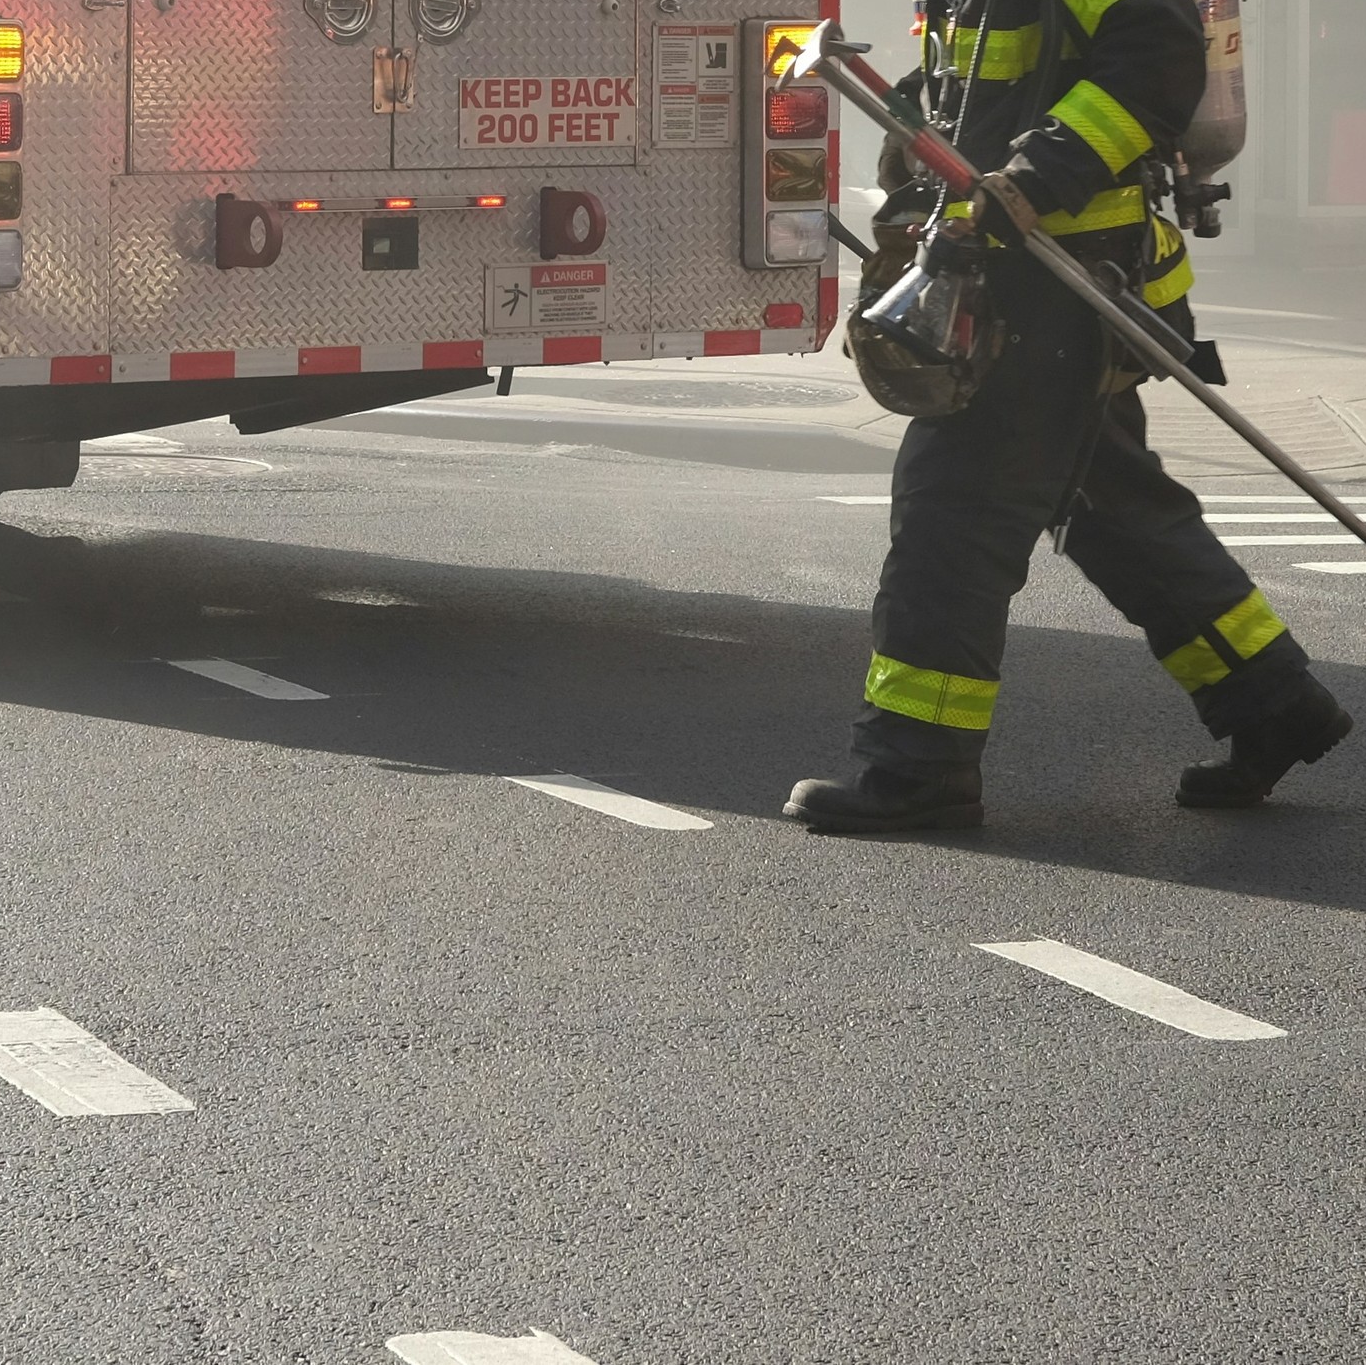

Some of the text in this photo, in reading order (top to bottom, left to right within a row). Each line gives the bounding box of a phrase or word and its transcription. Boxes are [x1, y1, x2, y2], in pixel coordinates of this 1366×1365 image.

[461, 77, 636, 109] KEEP BACK
[477, 112, 620, 144] 200 FEET
[553, 269, 594, 282] DANGER
